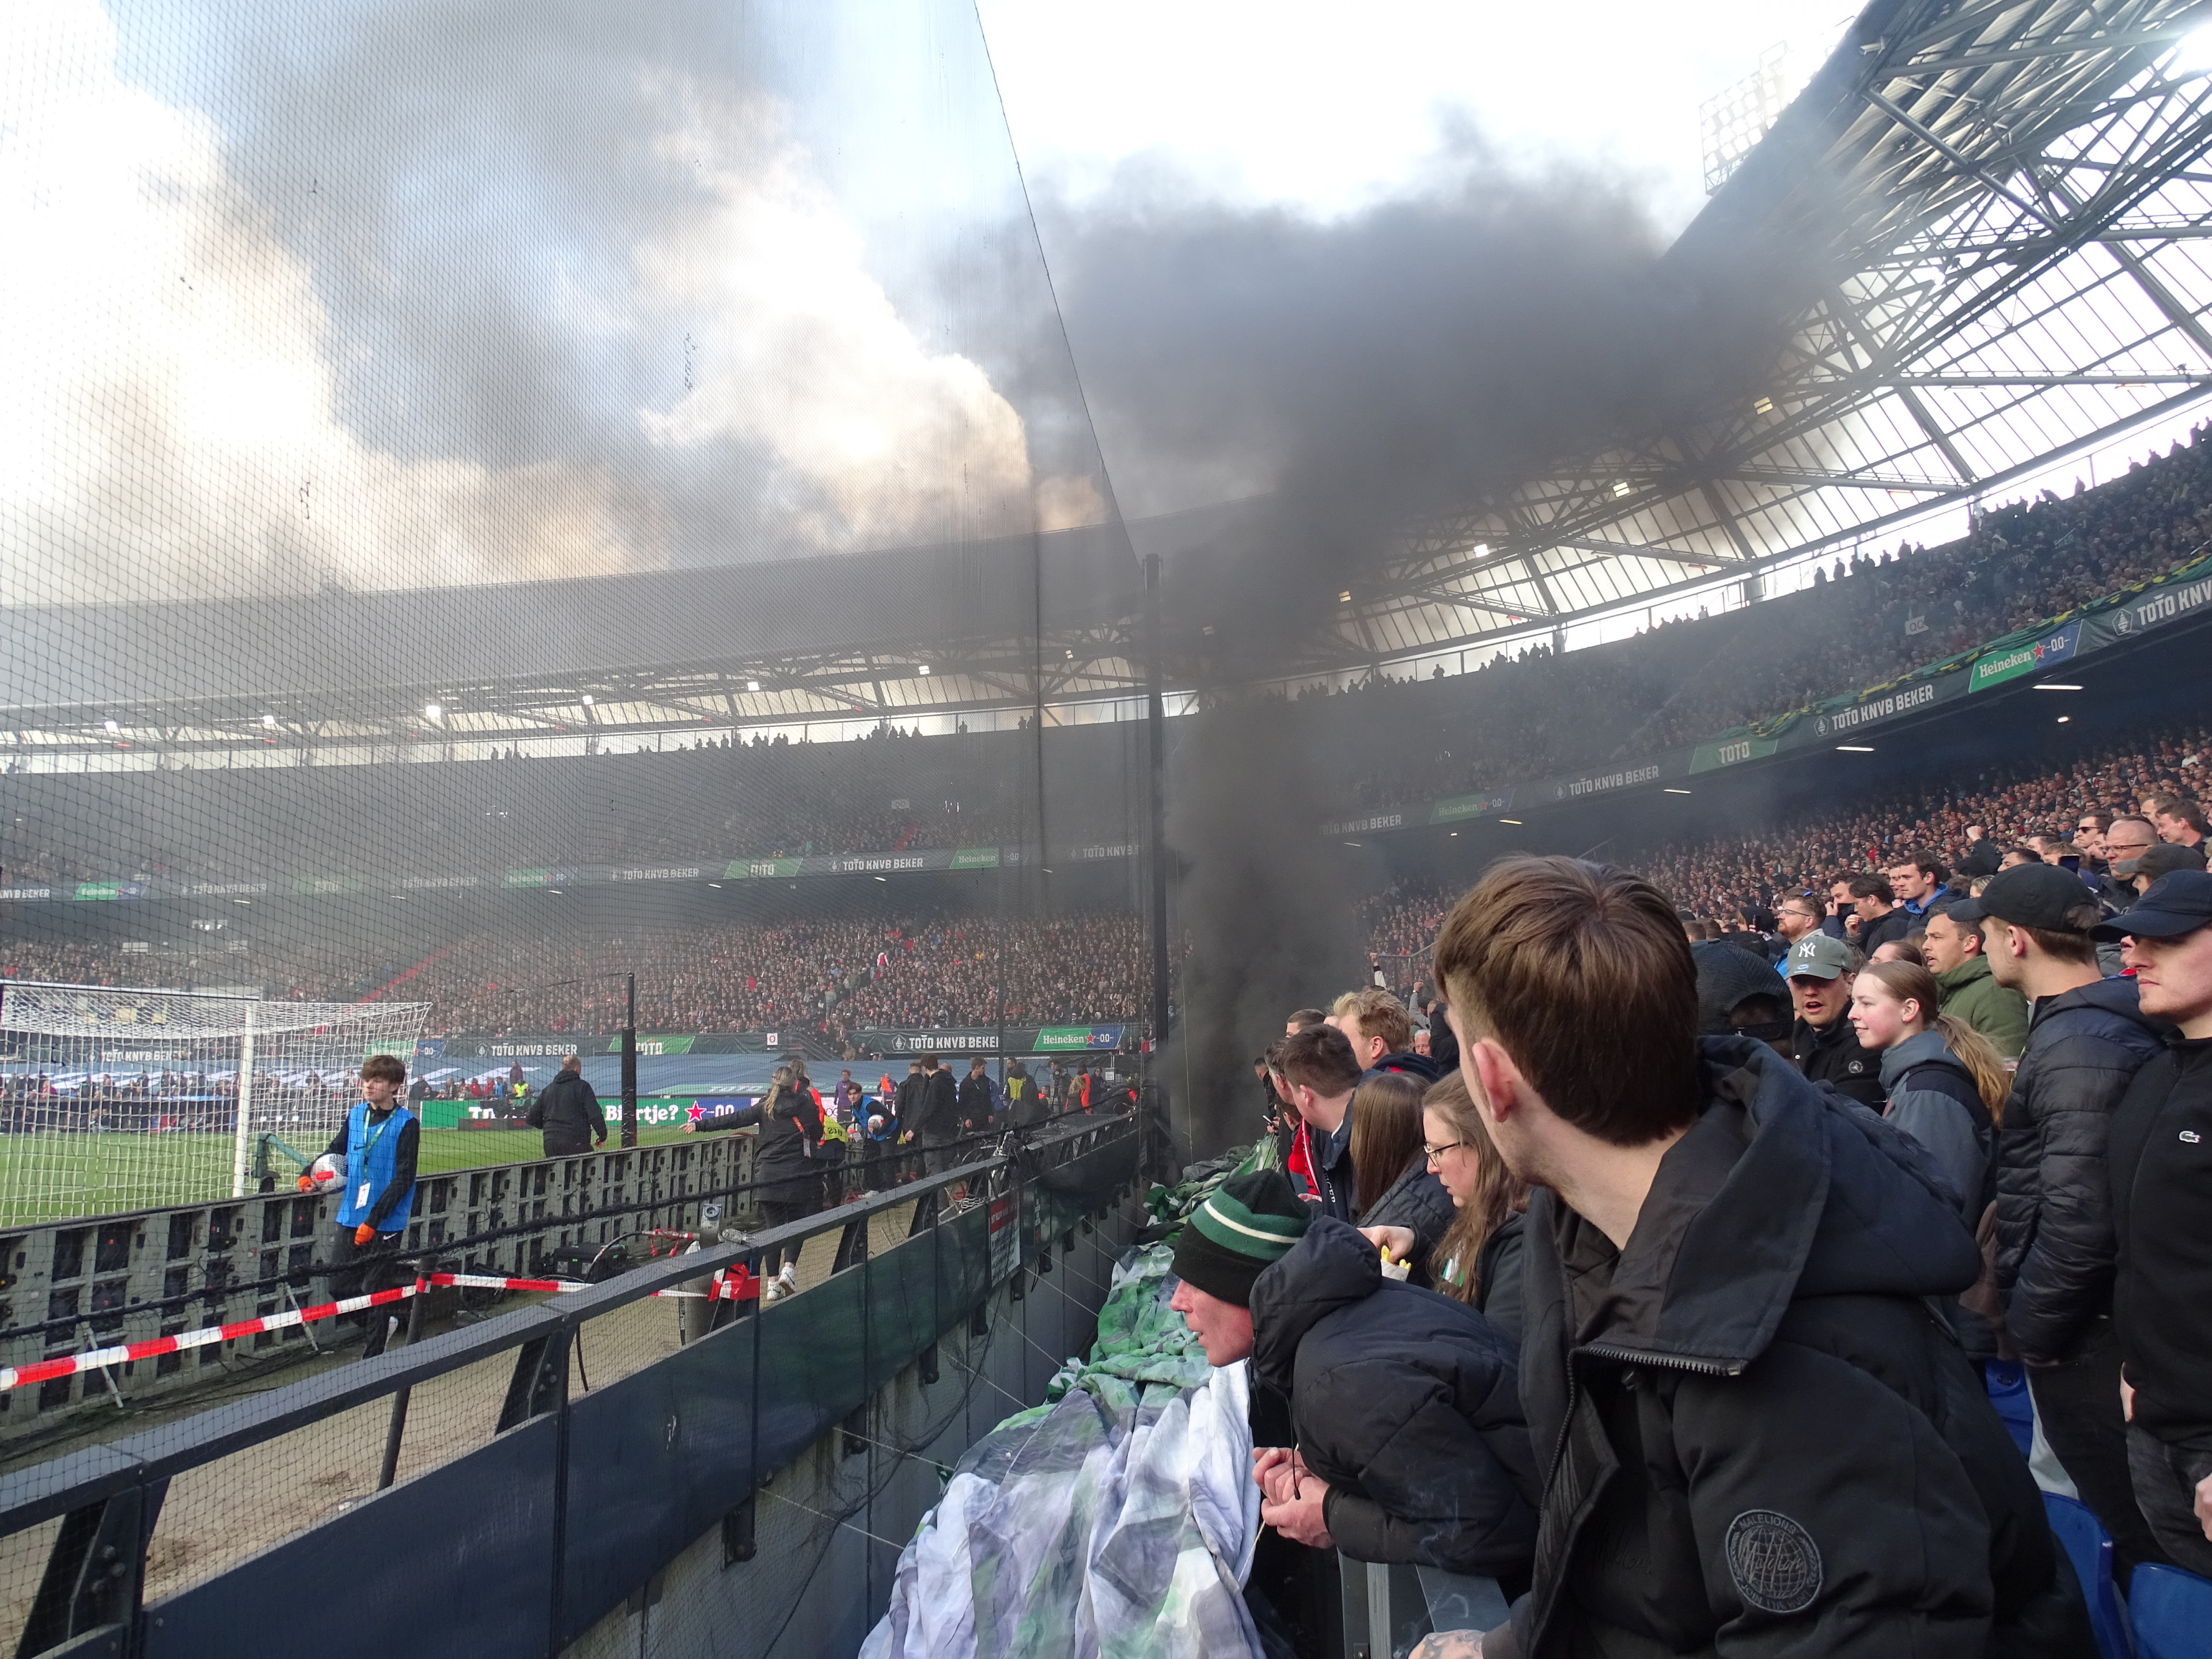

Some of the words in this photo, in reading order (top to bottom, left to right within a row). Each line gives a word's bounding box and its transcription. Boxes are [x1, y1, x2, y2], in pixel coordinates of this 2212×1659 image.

[2137, 593, 2175, 626] TOTO
[1979, 651, 2032, 678] Heineken
[1832, 707, 1858, 730] TOTO
[1860, 698, 1893, 722] KNVB
[1896, 684, 1934, 711] BEKER
[1718, 740, 1749, 764] TOTO
[1569, 778, 1593, 796] TOTO
[1594, 772, 1623, 790] KNVB
[1625, 765, 1659, 784] BEKER
[1438, 802, 1478, 816] Heineken
[1342, 819, 1368, 834] KNVB
[1369, 815, 1402, 830] BEKER
[959, 854, 996, 863] Heineken
[1083, 845, 1104, 858] TOTO
[843, 858, 865, 871] TOTO
[866, 859, 891, 870] KNVB
[893, 858, 923, 869] BEKER
[623, 868, 643, 880] TOTO
[645, 870, 669, 879] KNVB
[670, 868, 699, 878] BEKER
[22, 889, 50, 898] BEKER
[1798, 942, 1816, 957] NY
[909, 1035, 933, 1049] TOTO
[936, 1037, 966, 1048] KNVB
[1043, 1035, 1084, 1044] Heineken
[491, 1043, 514, 1056] TOTO
[516, 1045, 543, 1056] KNVB
[545, 1044, 577, 1055] BEKER
[605, 1104, 680, 1125] Birtje?
[1740, 1514, 1796, 1535] MALELIONS
